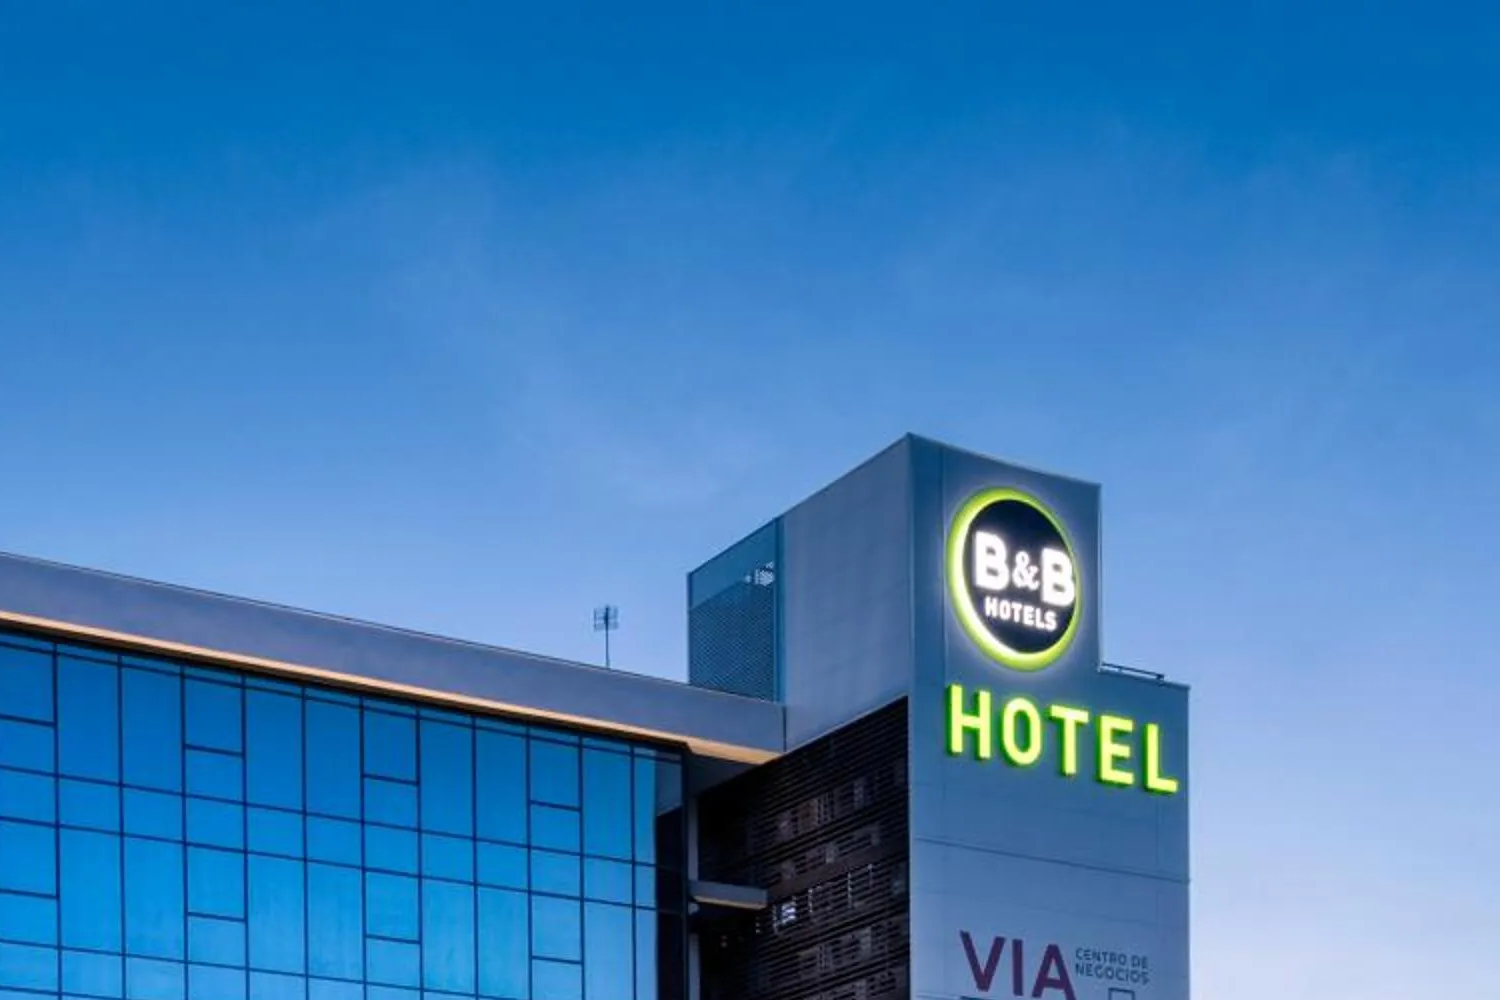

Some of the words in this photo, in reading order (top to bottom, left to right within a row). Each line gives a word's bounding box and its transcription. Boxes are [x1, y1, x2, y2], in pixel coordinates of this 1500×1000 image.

[973, 530, 1076, 607] B&B
[984, 596, 1058, 631] HOTELS
[946, 683, 1180, 794] HOTEL
[1075, 947, 1128, 966] CENTRO
[1131, 953, 1148, 969] DE
[1075, 963, 1150, 985] NEGOCIOS
